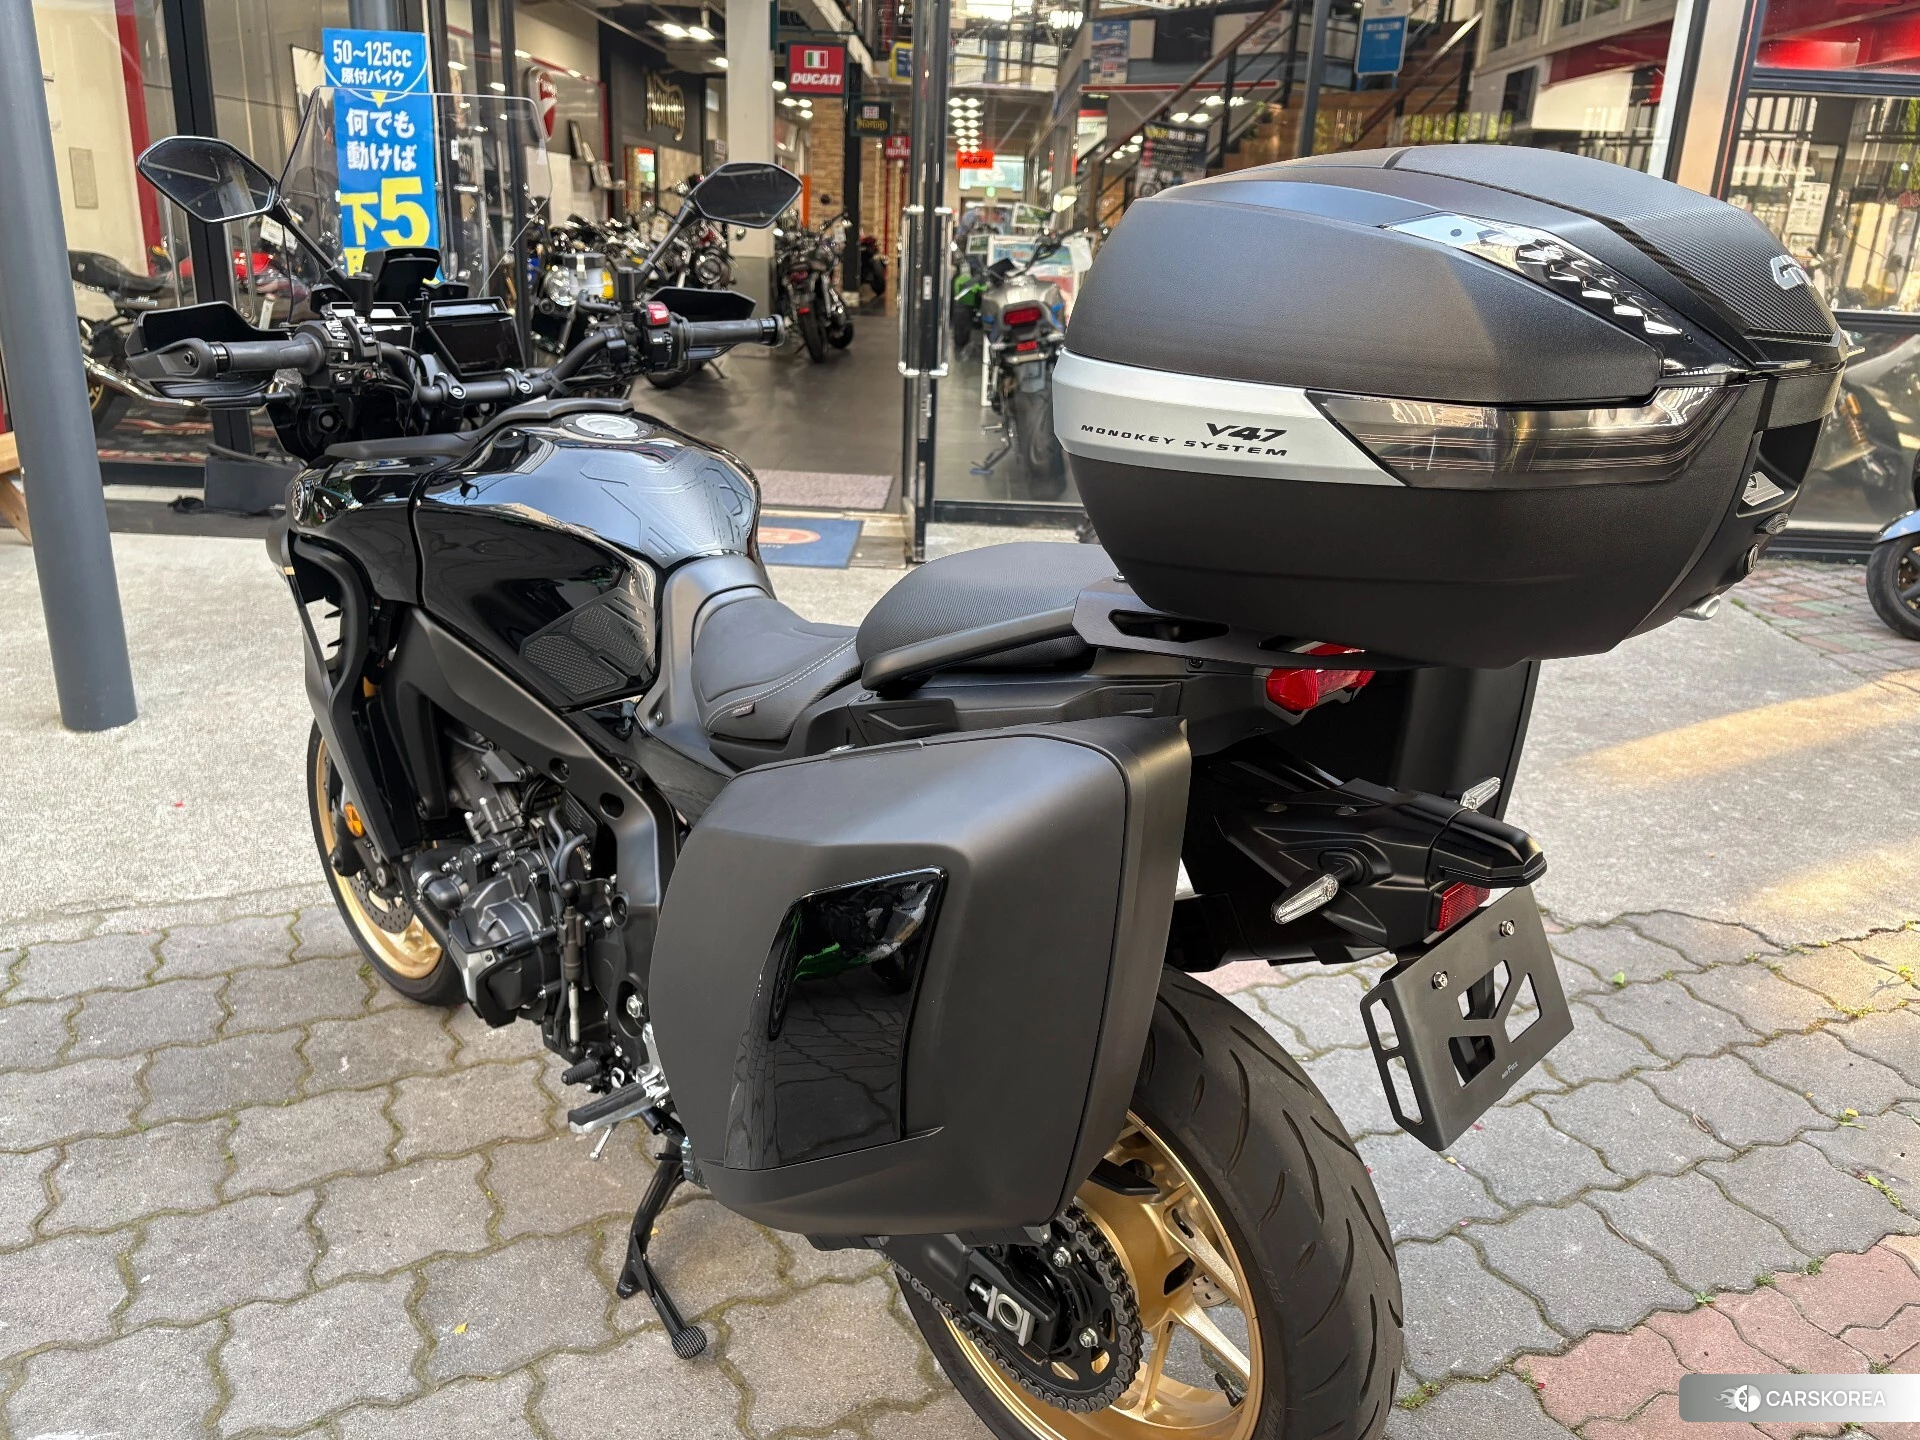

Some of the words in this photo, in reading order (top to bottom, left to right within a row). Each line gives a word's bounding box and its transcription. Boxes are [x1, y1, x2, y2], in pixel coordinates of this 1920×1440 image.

[340, 67, 405, 87] 原付バイク
[791, 73, 842, 85] DUCATI
[345, 108, 415, 138] 何でも
[346, 140, 417, 172] 動けば
[1080, 424, 1176, 445] MONOKEY
[1183, 440, 1288, 457] SYSTEM
[1206, 422, 1288, 443] V47
